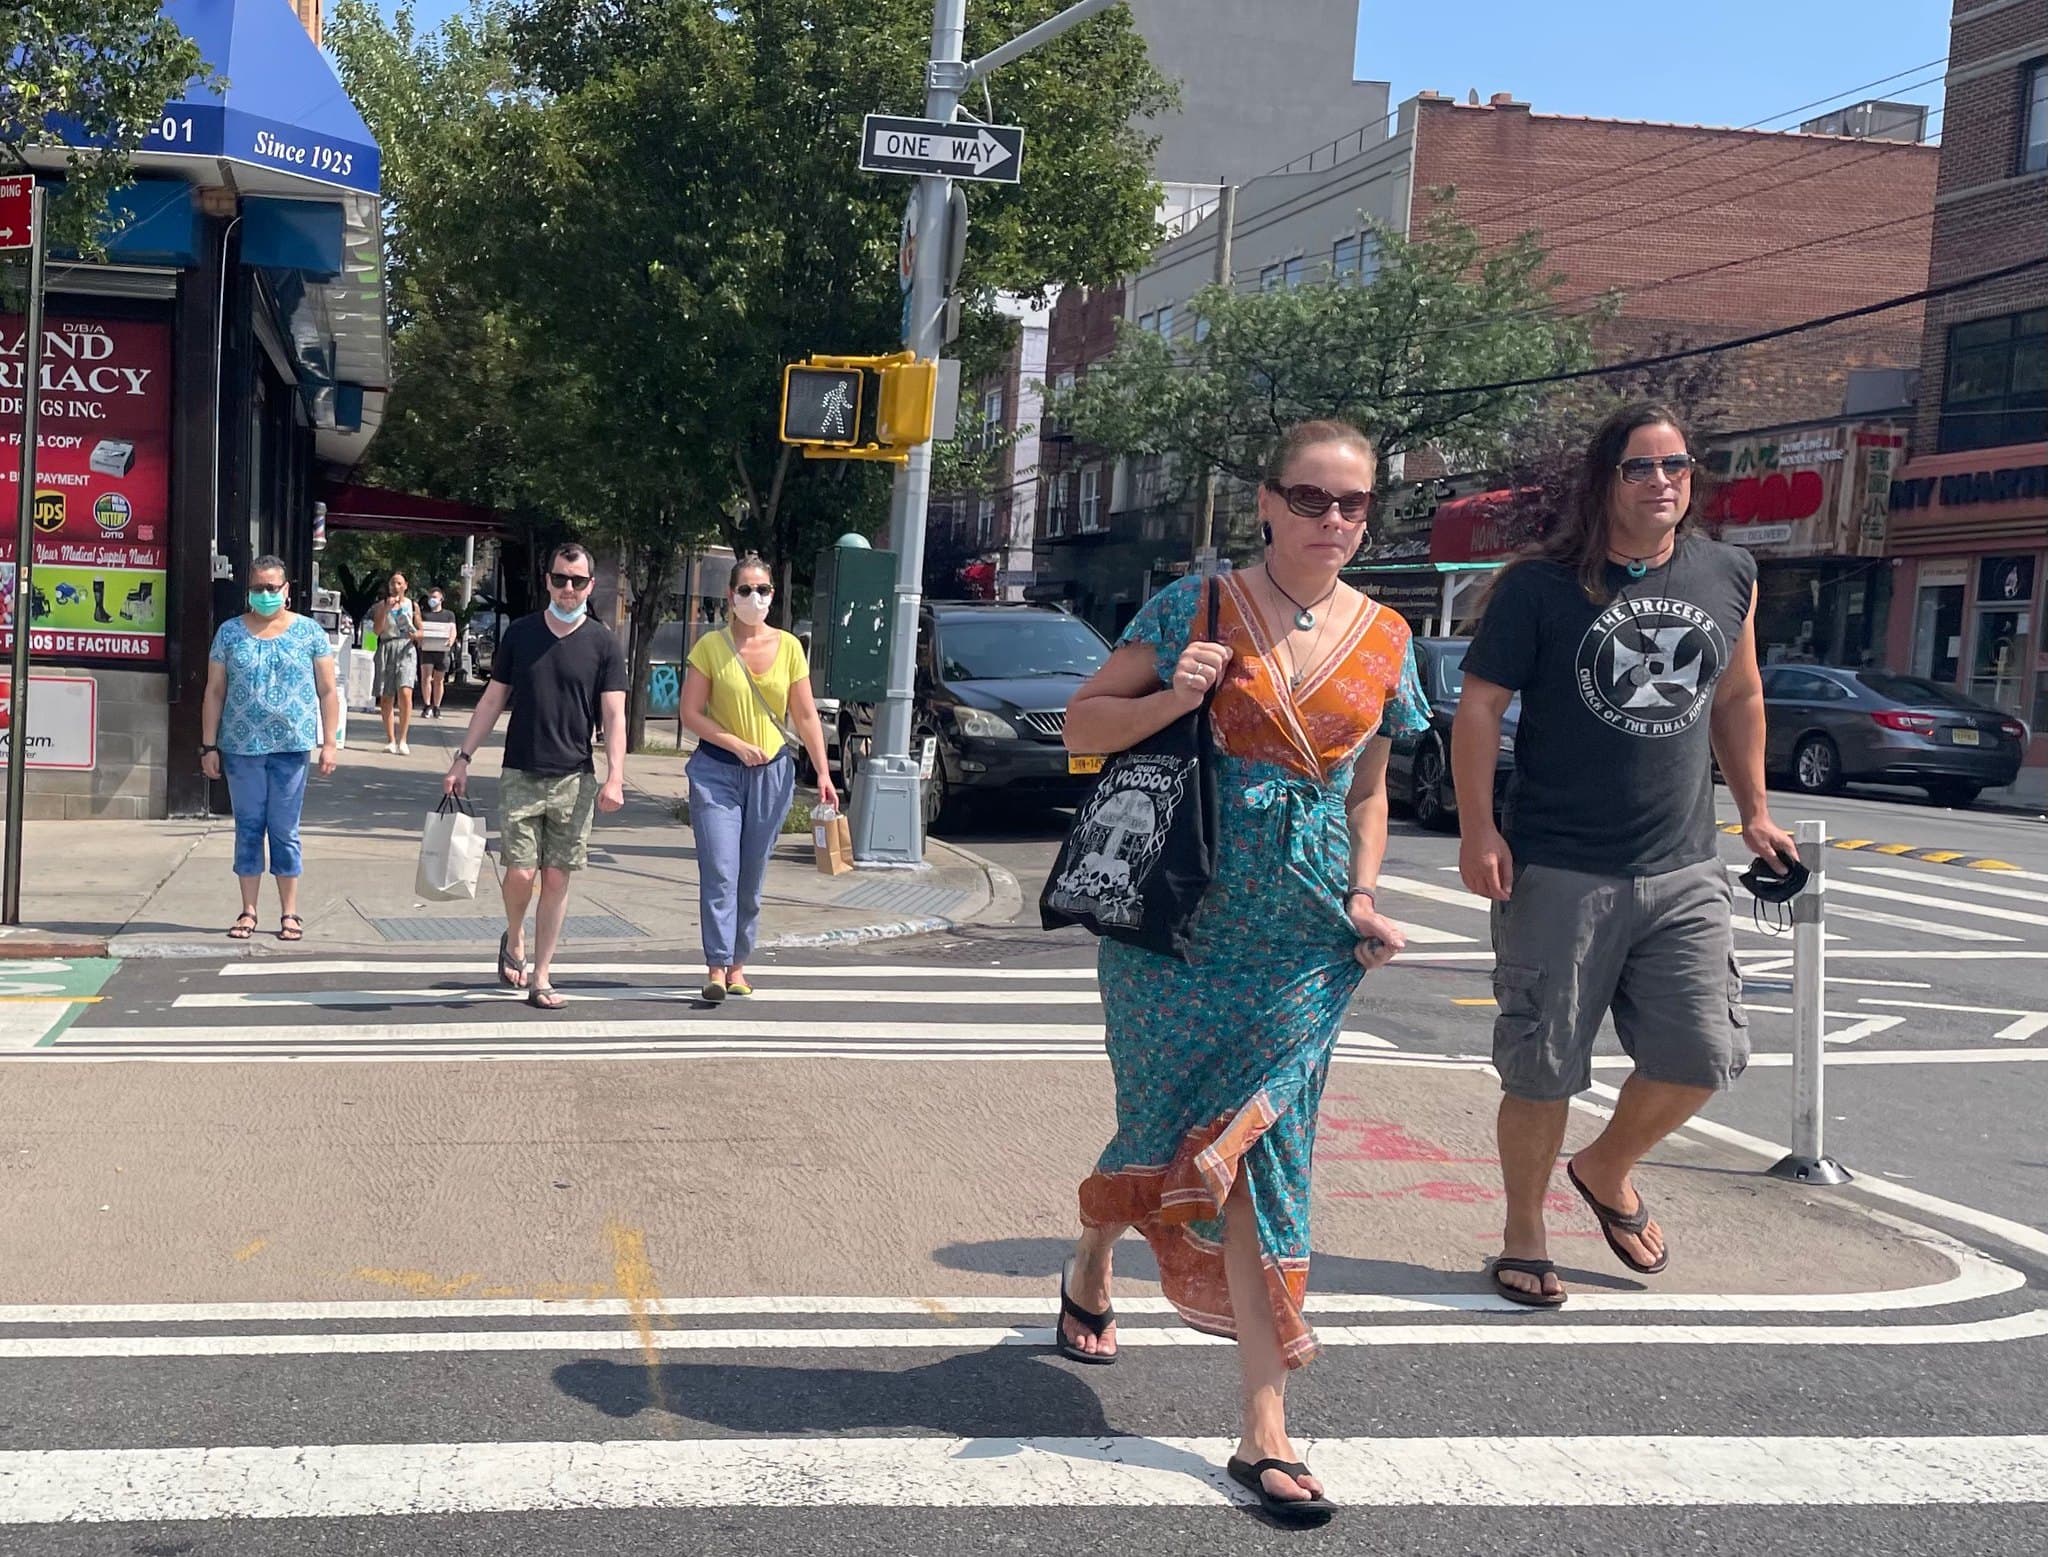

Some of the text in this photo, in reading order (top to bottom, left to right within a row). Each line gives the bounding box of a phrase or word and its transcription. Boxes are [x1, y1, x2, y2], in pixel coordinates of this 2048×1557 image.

[254, 131, 353, 176] Since 1925
[887, 135, 997, 163] ONE WAY
[63, 323, 105, 334] D/B/A
[69, 401, 106, 418] INC.
[47, 436, 82, 449] COPY
[36, 473, 90, 486] PAYMENT
[101, 530, 124, 539] LOTTO
[36, 543, 58, 563] Your
[61, 544, 96, 561] Medical
[97, 546, 127, 567] Supply
[129, 547, 153, 565] Needs
[1593, 601, 1714, 634] THE PROCESS
[5, 634, 150, 654] POS DE FACTURAS
[1580, 668, 1604, 711] CHURCH
[1603, 710, 1622, 722] OF
[1625, 719, 1647, 734] THE
[1653, 719, 1686, 734] FINAL
[1116, 769, 1172, 791] VOODOO
